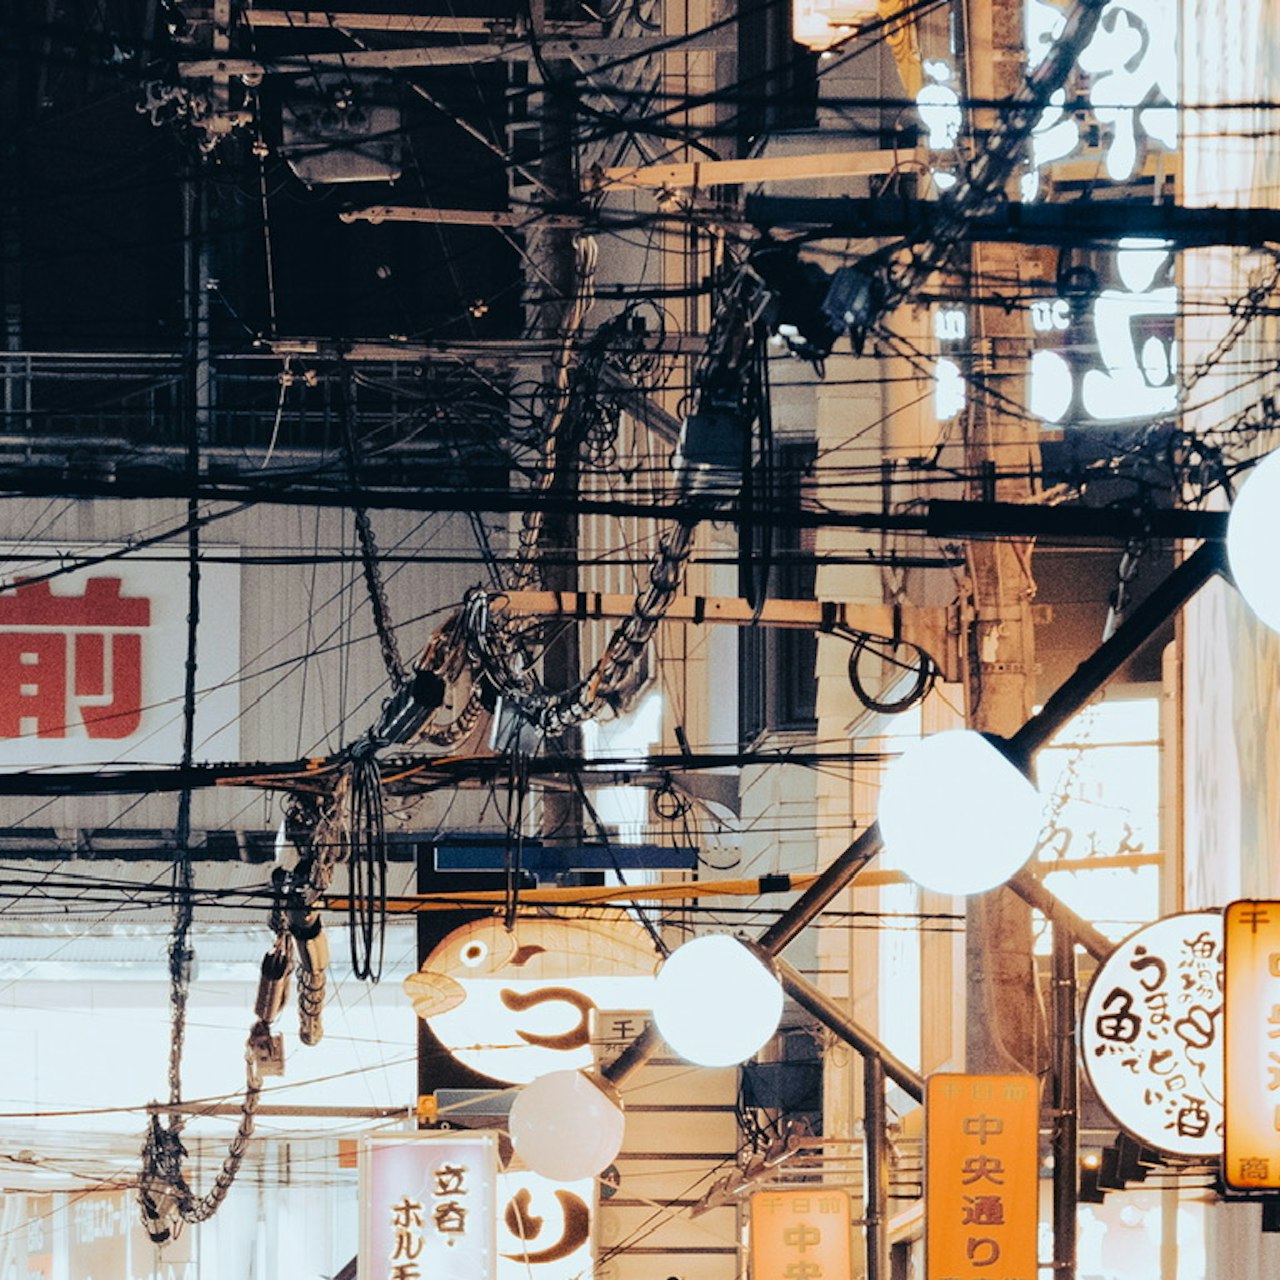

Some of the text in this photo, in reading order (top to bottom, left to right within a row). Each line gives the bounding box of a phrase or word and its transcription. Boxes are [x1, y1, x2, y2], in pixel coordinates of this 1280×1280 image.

[939, 1083, 1029, 1101] 千日前
[962, 1113, 1005, 1267] 中央通り
[761, 1196, 842, 1215] 千日前
